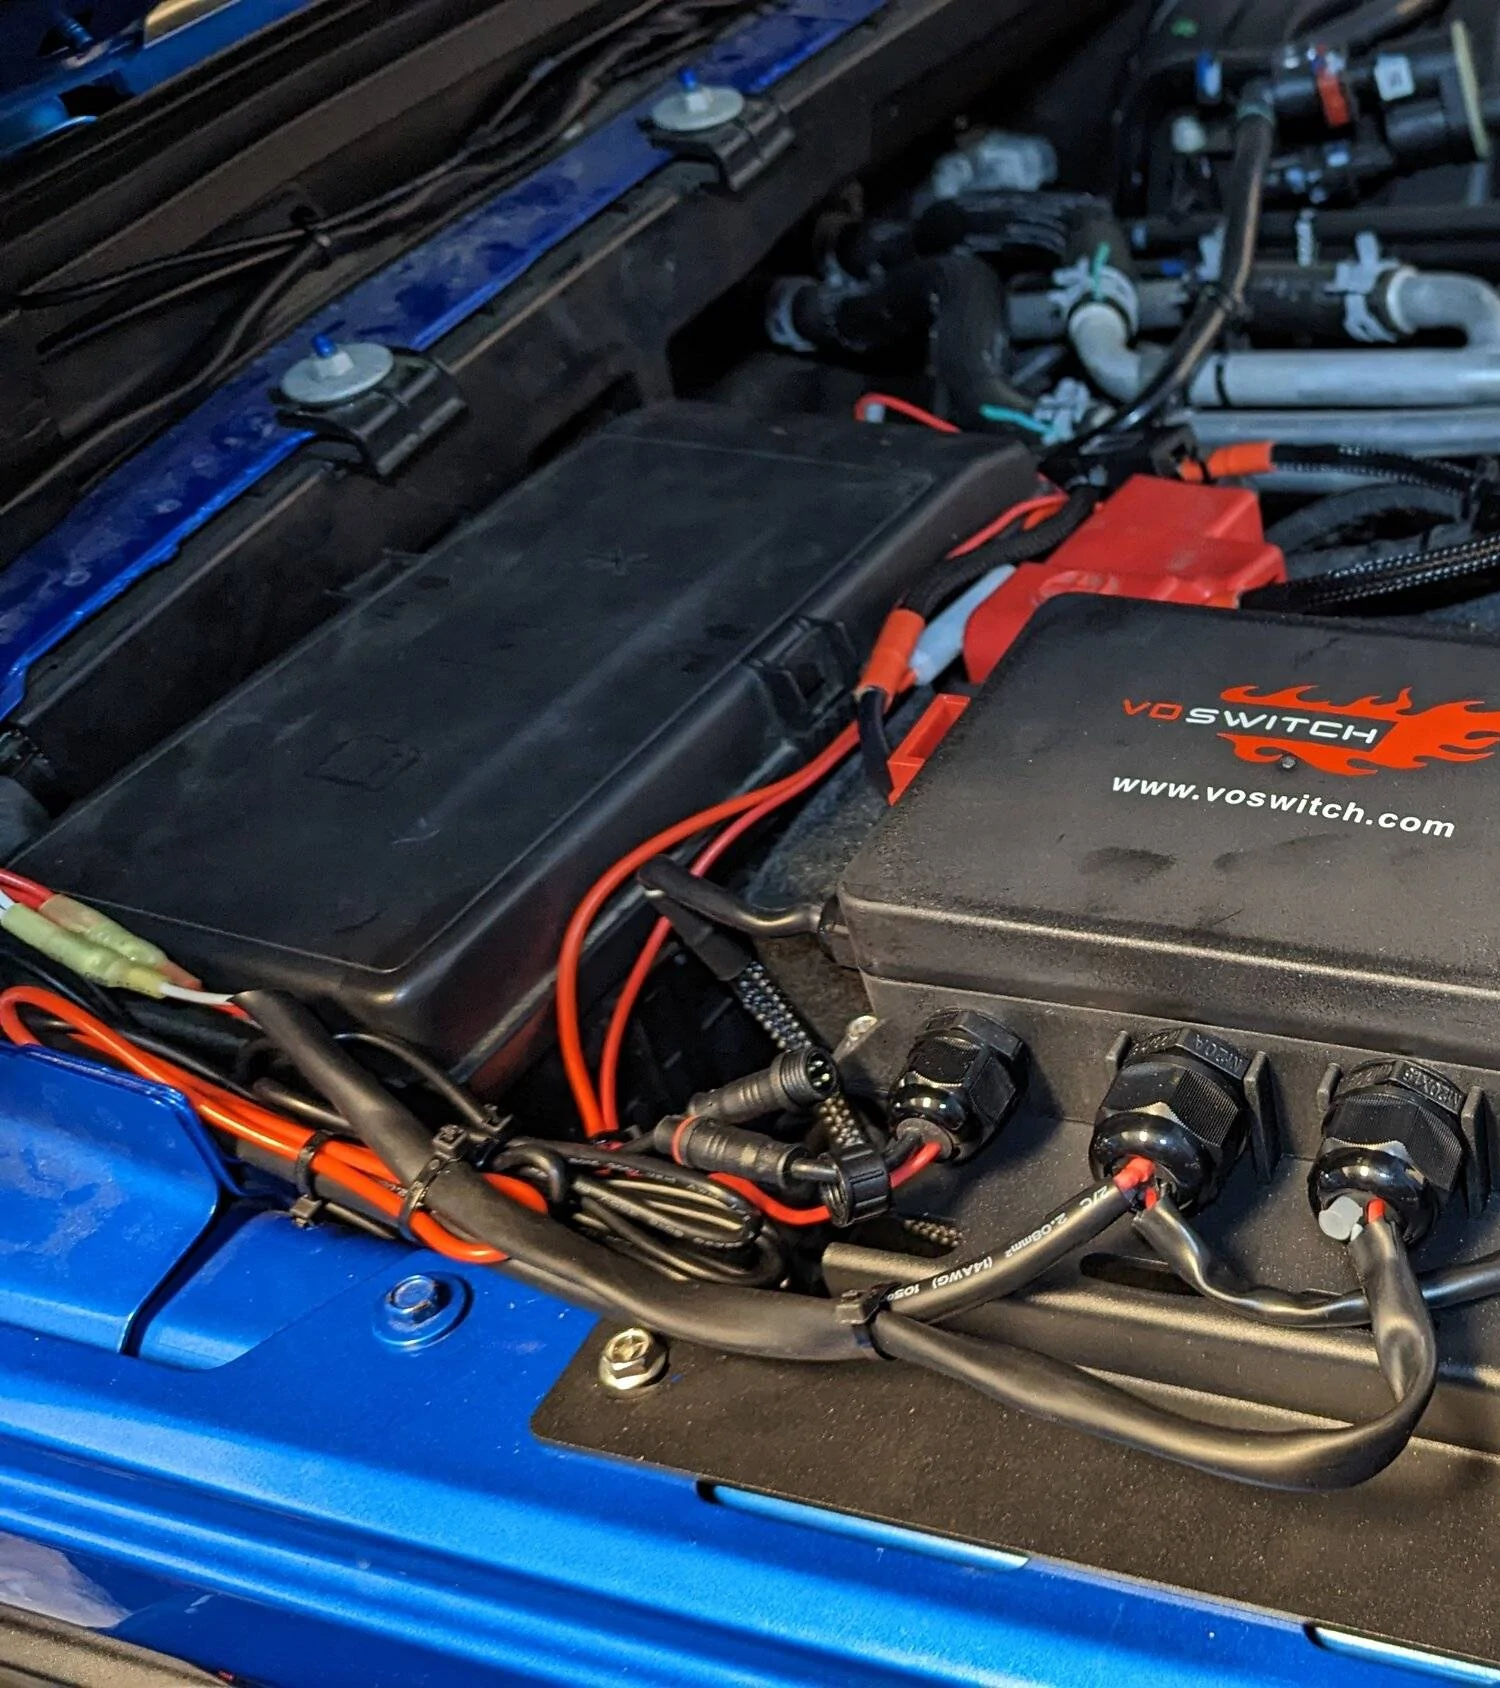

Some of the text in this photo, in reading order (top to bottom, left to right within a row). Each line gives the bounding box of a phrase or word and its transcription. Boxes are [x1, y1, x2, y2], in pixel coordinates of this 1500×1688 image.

[1123, 698, 1377, 745] VOSWITCH
[1111, 773, 1455, 838] www.voswitch.com
[932, 1256, 993, 1289] (14AWG)
